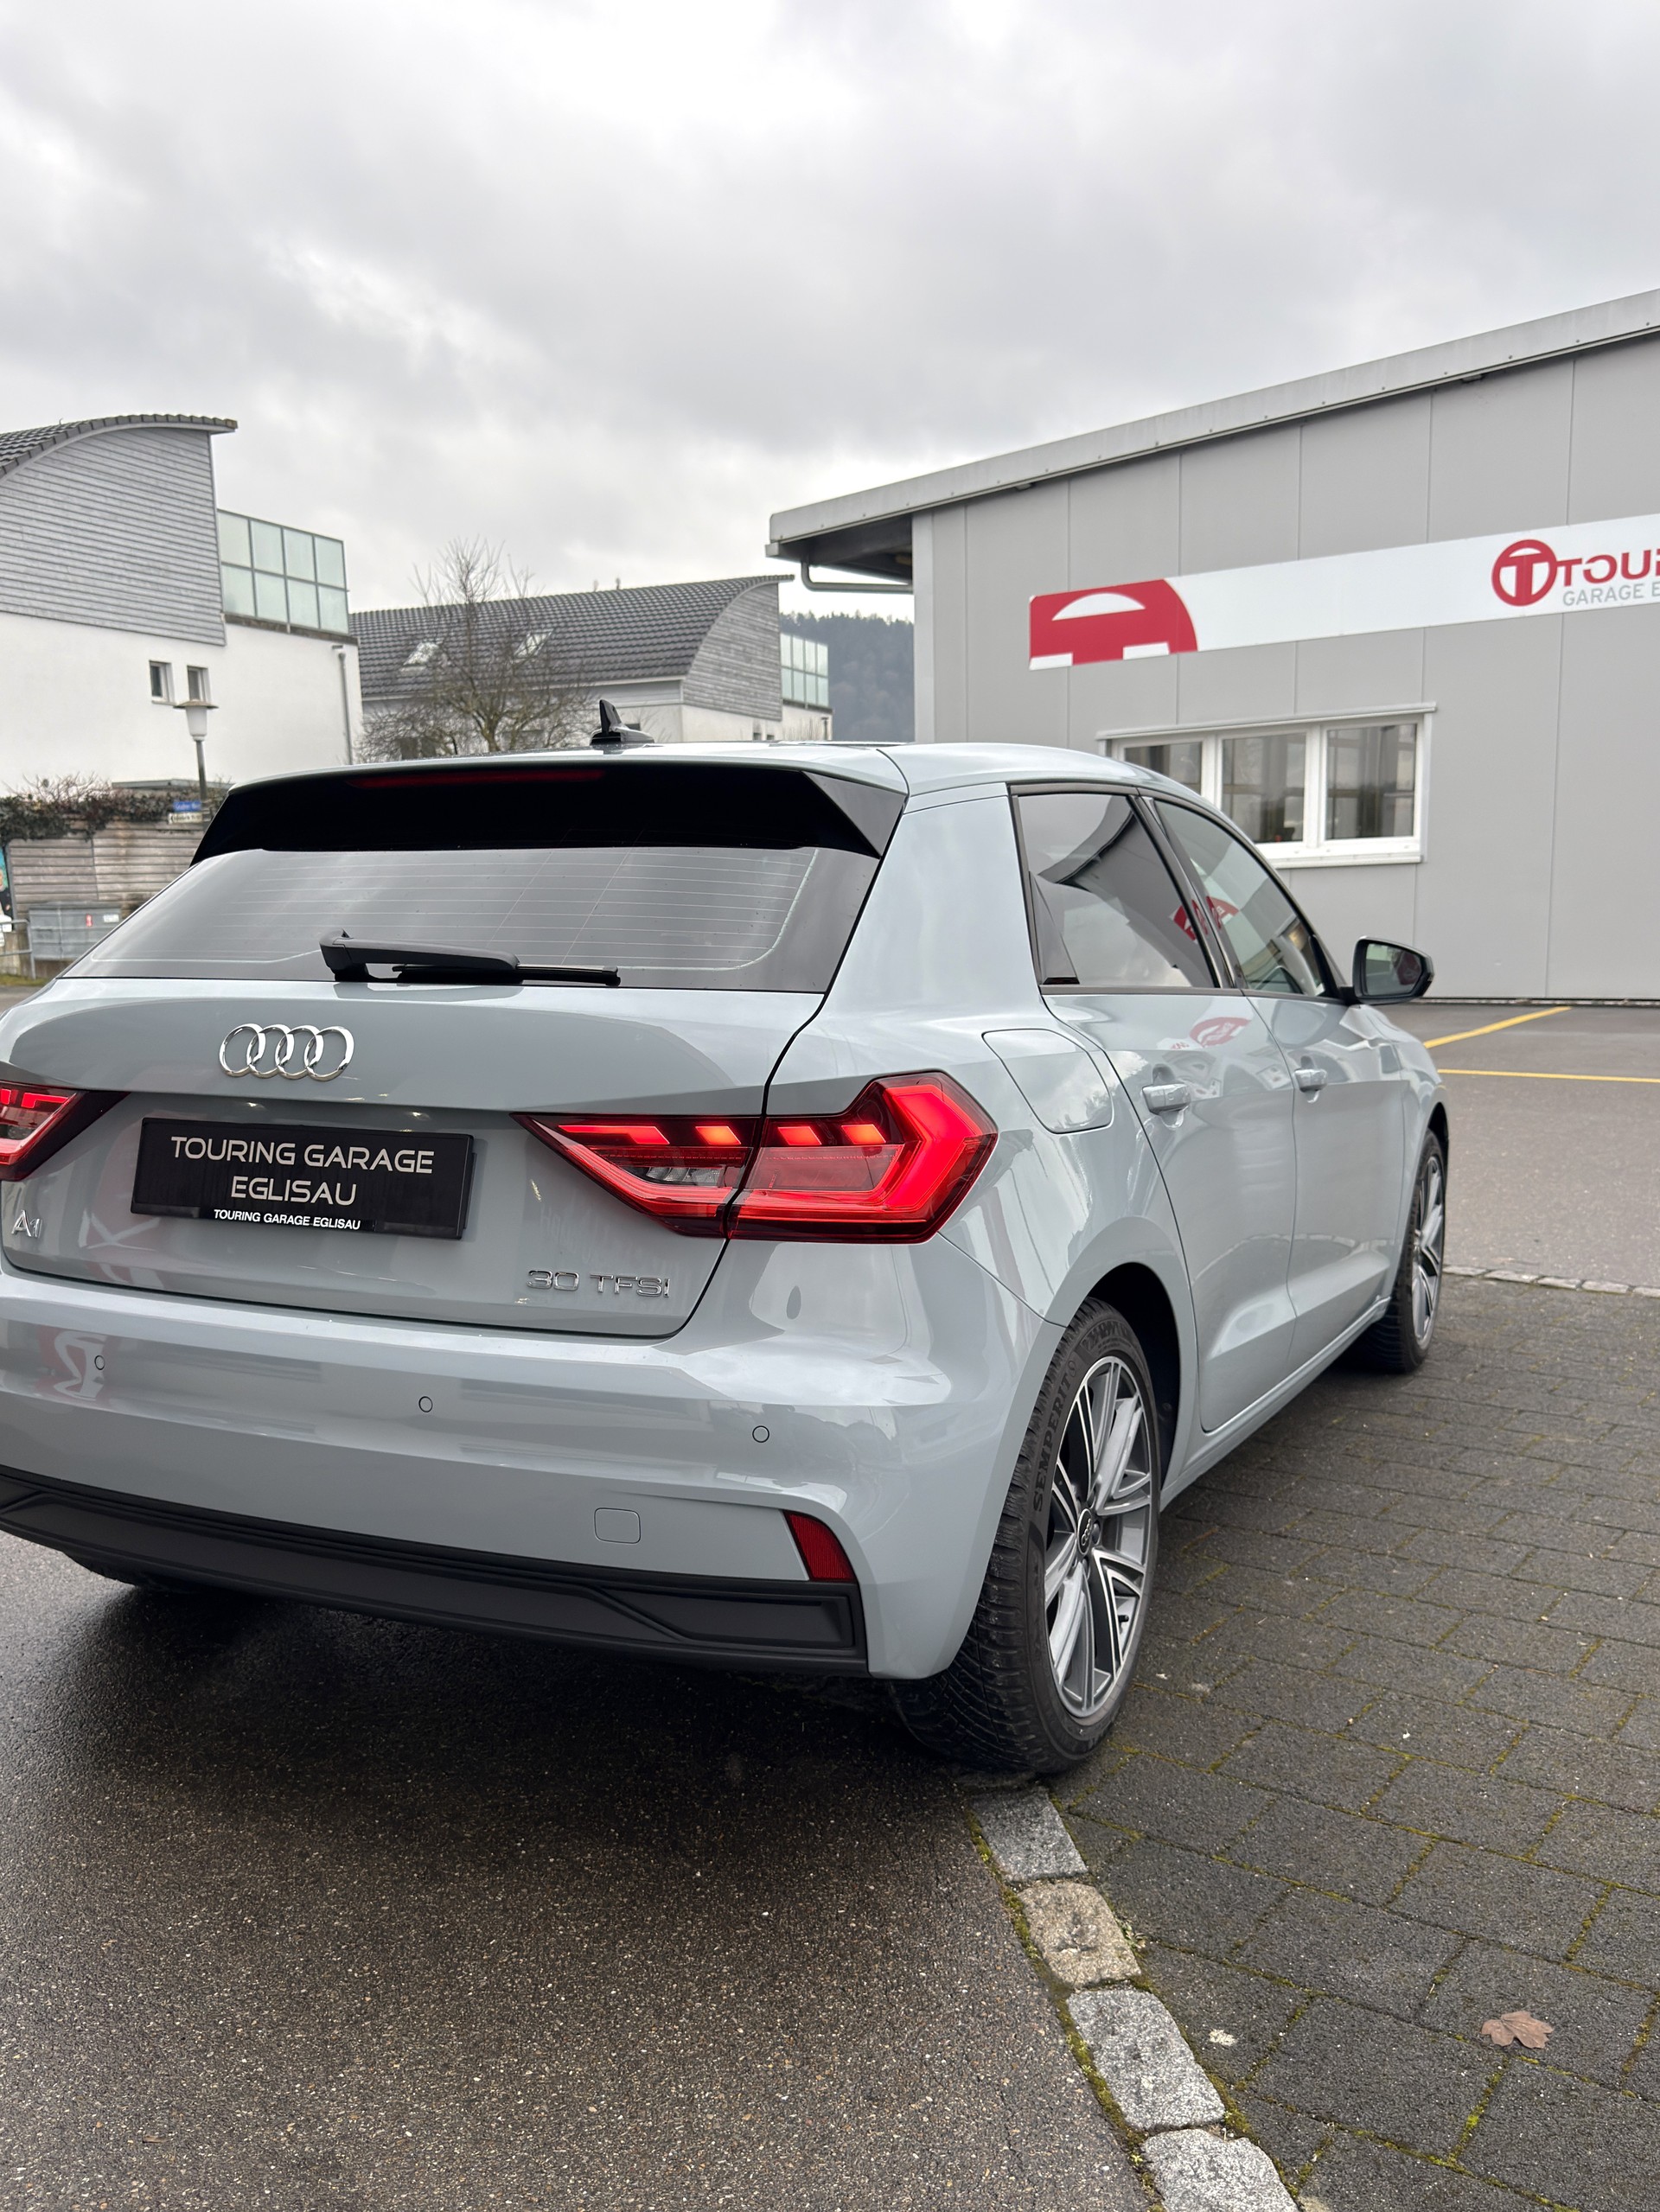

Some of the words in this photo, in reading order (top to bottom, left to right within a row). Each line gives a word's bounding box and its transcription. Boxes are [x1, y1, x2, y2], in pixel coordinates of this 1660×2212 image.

[1556, 548, 1660, 587] TOU
[1563, 583, 1644, 606] GARAGE
[171, 1136, 296, 1165] TOURING
[304, 1144, 435, 1174] GARAGE
[231, 1176, 357, 1206] EGLISAU
[11, 1210, 42, 1238] A1
[214, 1208, 261, 1222] TOURING
[264, 1213, 310, 1227] GARAGE
[313, 1216, 361, 1231] EGLISAU
[527, 1270, 579, 1291] 30
[590, 1274, 671, 1297] TFSI
